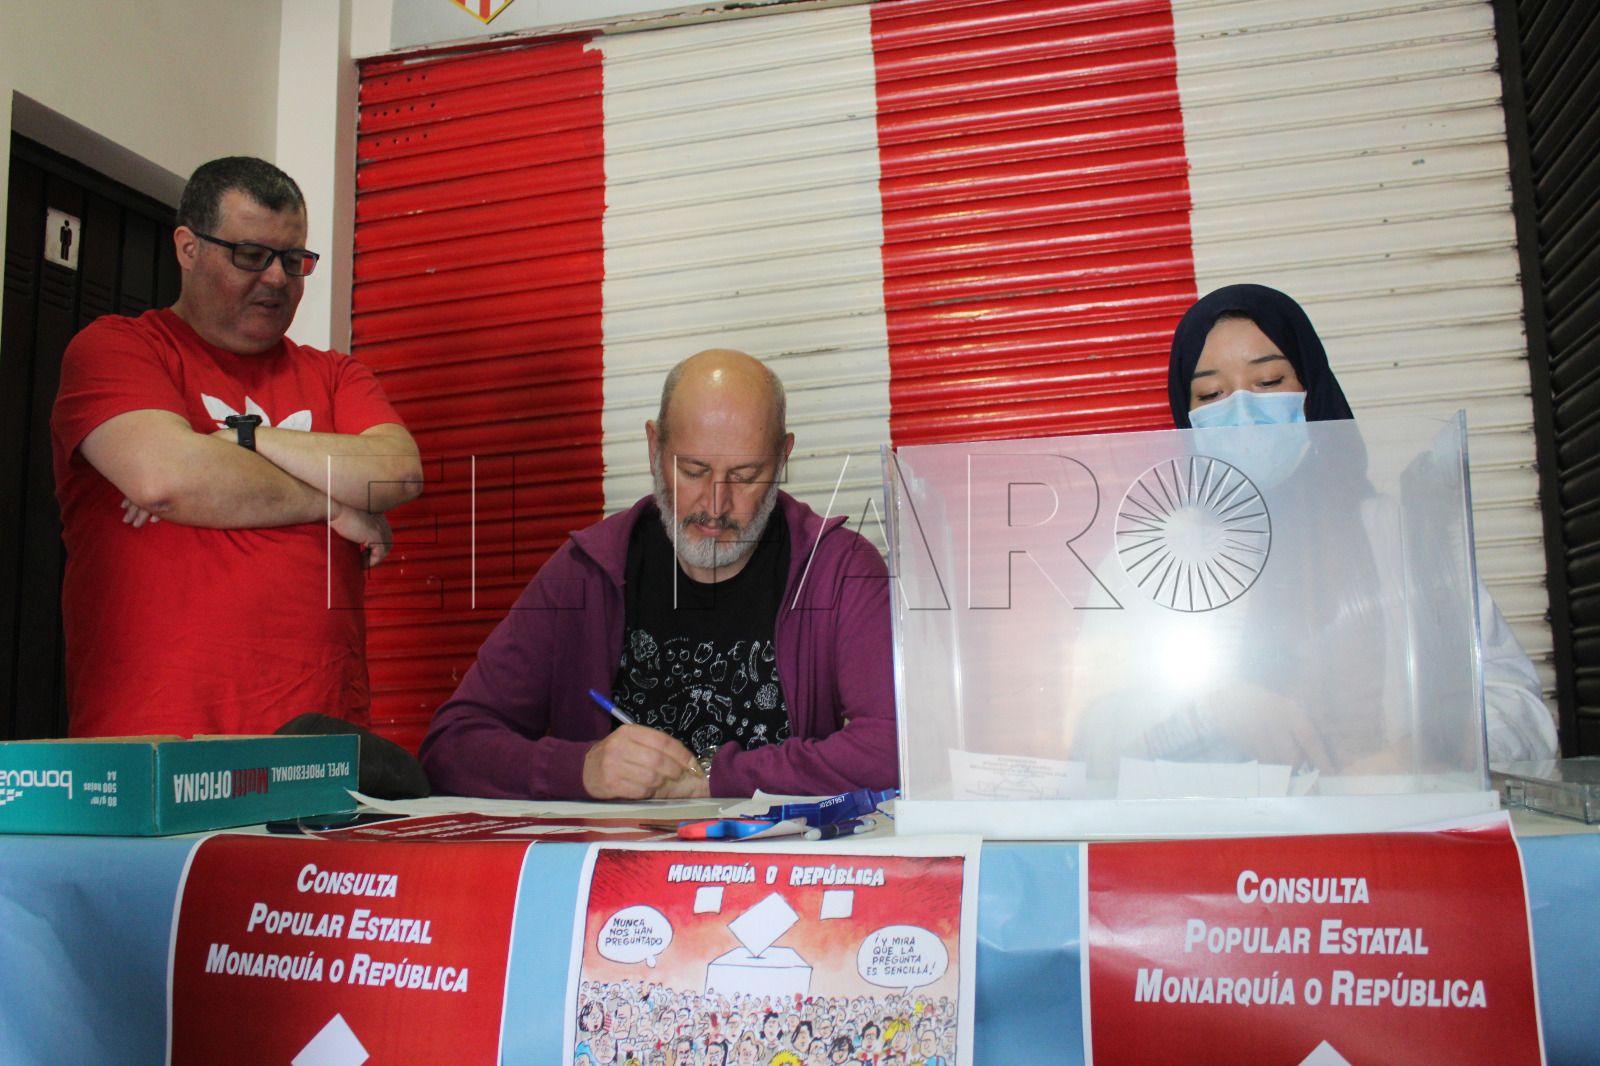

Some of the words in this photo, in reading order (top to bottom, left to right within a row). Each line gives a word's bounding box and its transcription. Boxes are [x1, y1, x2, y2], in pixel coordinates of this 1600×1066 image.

[107, 770, 117, 781] A4
[271, 763, 325, 783] PROFESIONAL
[328, 761, 350, 777] PAPEL
[83, 782, 102, 792] hojas
[102, 782, 117, 793] 500
[107, 796, 117, 807] 80
[297, 863, 399, 897] CONSULTA
[667, 862, 756, 885] MONARQUÍA
[764, 865, 779, 885] O
[789, 863, 886, 887] REPÚBLICA
[1236, 870, 1370, 904] CONSULTA
[246, 902, 345, 939] POPULAR
[347, 908, 433, 945] ESTATAL
[613, 918, 645, 928] NUNCA
[609, 928, 629, 937] NOS
[634, 926, 653, 935] HAN
[1184, 919, 1310, 955] POPULAR
[1319, 919, 1429, 956] ESTATAL
[605, 936, 663, 947] PREGUNTADO
[892, 936, 916, 945] MIRA
[873, 946, 893, 955] QUE
[901, 946, 914, 955] LA
[872, 955, 922, 966] PREGUNTA
[205, 943, 324, 982] MONARQUÍA
[347, 953, 469, 993] REPÚBLICA
[866, 967, 877, 976] ES
[884, 961, 936, 976] SENCILLA!
[1134, 968, 1296, 1009] MONARQUÍA
[1330, 969, 1488, 1009] REPÚBLICA
